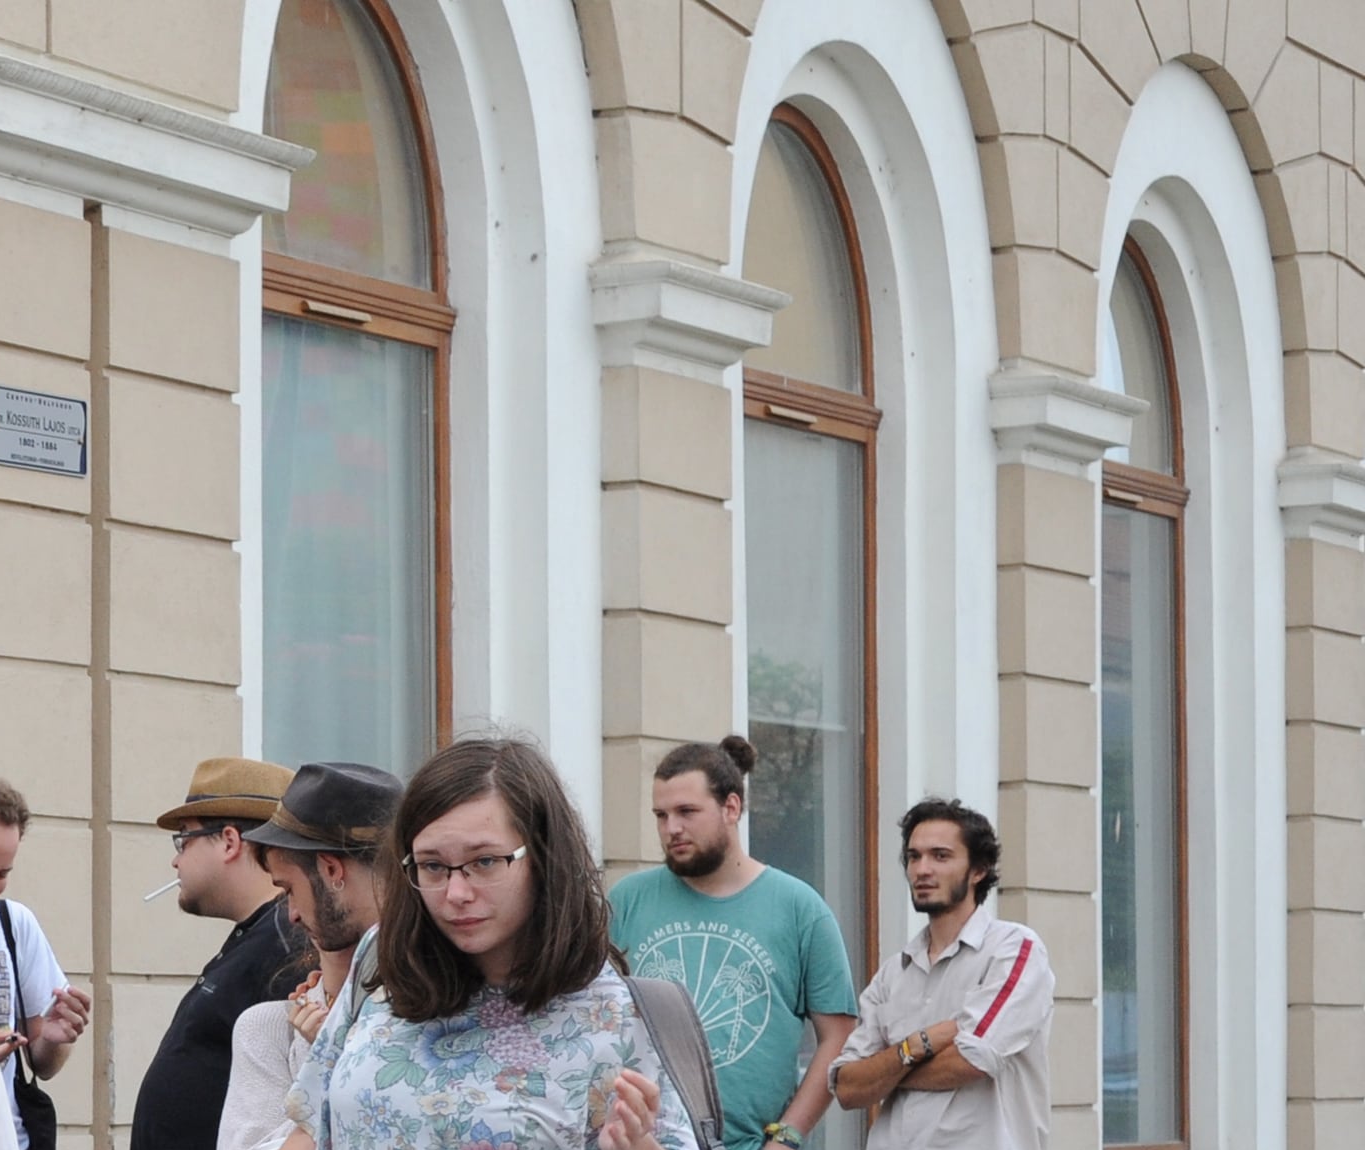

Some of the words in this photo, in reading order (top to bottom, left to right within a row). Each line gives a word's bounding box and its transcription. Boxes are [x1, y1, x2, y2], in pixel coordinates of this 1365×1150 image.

[632, 920, 691, 962] ROAMERS
[697, 920, 729, 935] AND
[731, 928, 777, 976] SEEKERS
